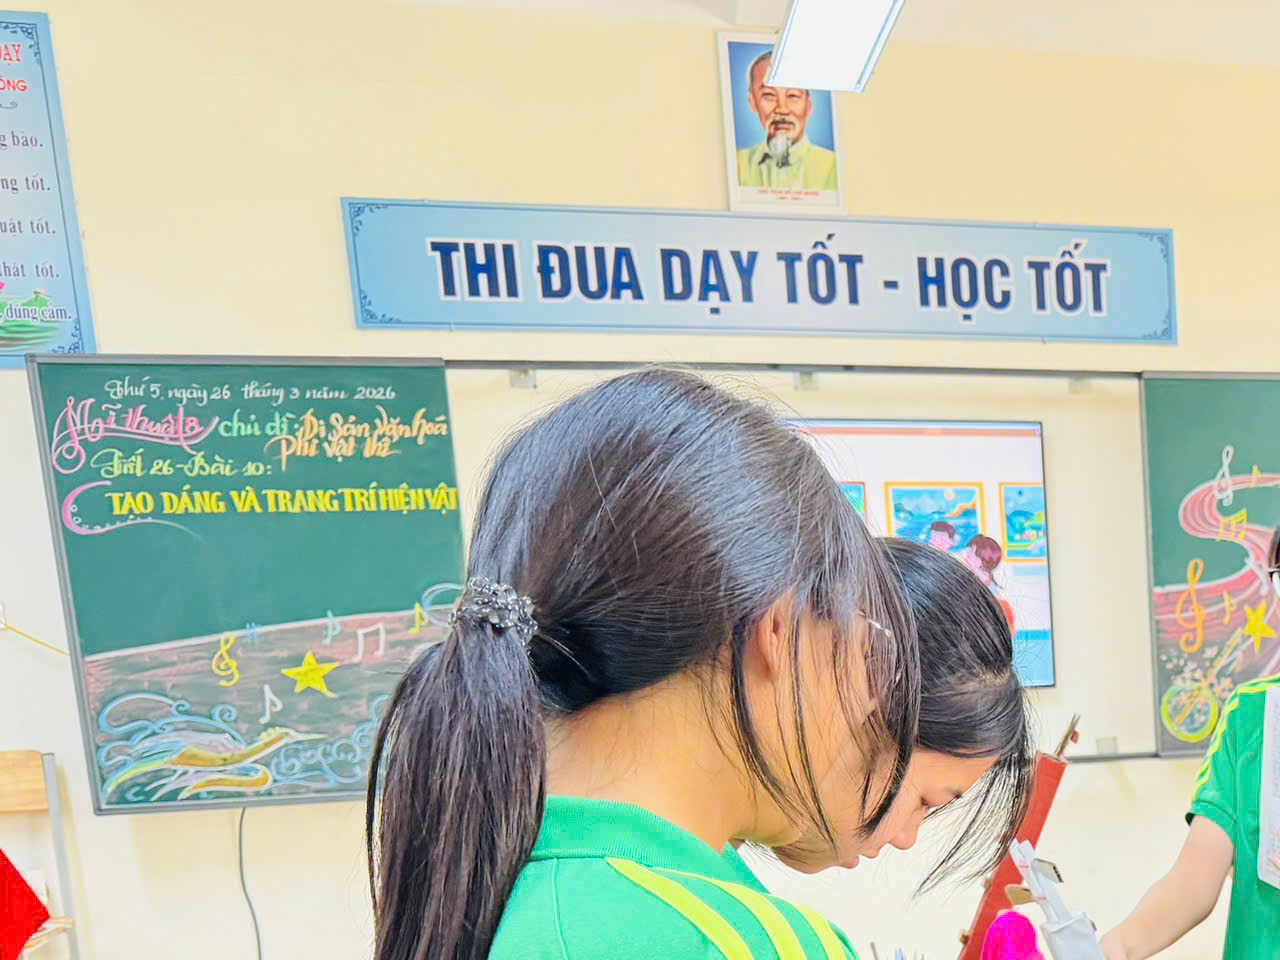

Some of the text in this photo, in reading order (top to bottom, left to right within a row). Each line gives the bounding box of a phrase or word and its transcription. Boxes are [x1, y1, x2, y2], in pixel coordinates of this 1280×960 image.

[0, 43, 21, 66] ẠY
[25, 173, 51, 192] tốt.
[0, 217, 56, 237] uật tốt.
[35, 261, 60, 279] tốt.
[429, 233, 1108, 321] THI ĐUA DẠY TỐT - HỌC TỐT
[168, 384, 208, 407] ngày
[209, 384, 231, 400] 26
[241, 379, 285, 407] tháng
[289, 385, 300, 400] 3
[305, 385, 347, 400] năm
[353, 385, 398, 401] 2026
[218, 408, 260, 437] chủ
[104, 480, 460, 520] TẠO DÁNG VÀ TRANG TRÍ HIỆN VẬT
